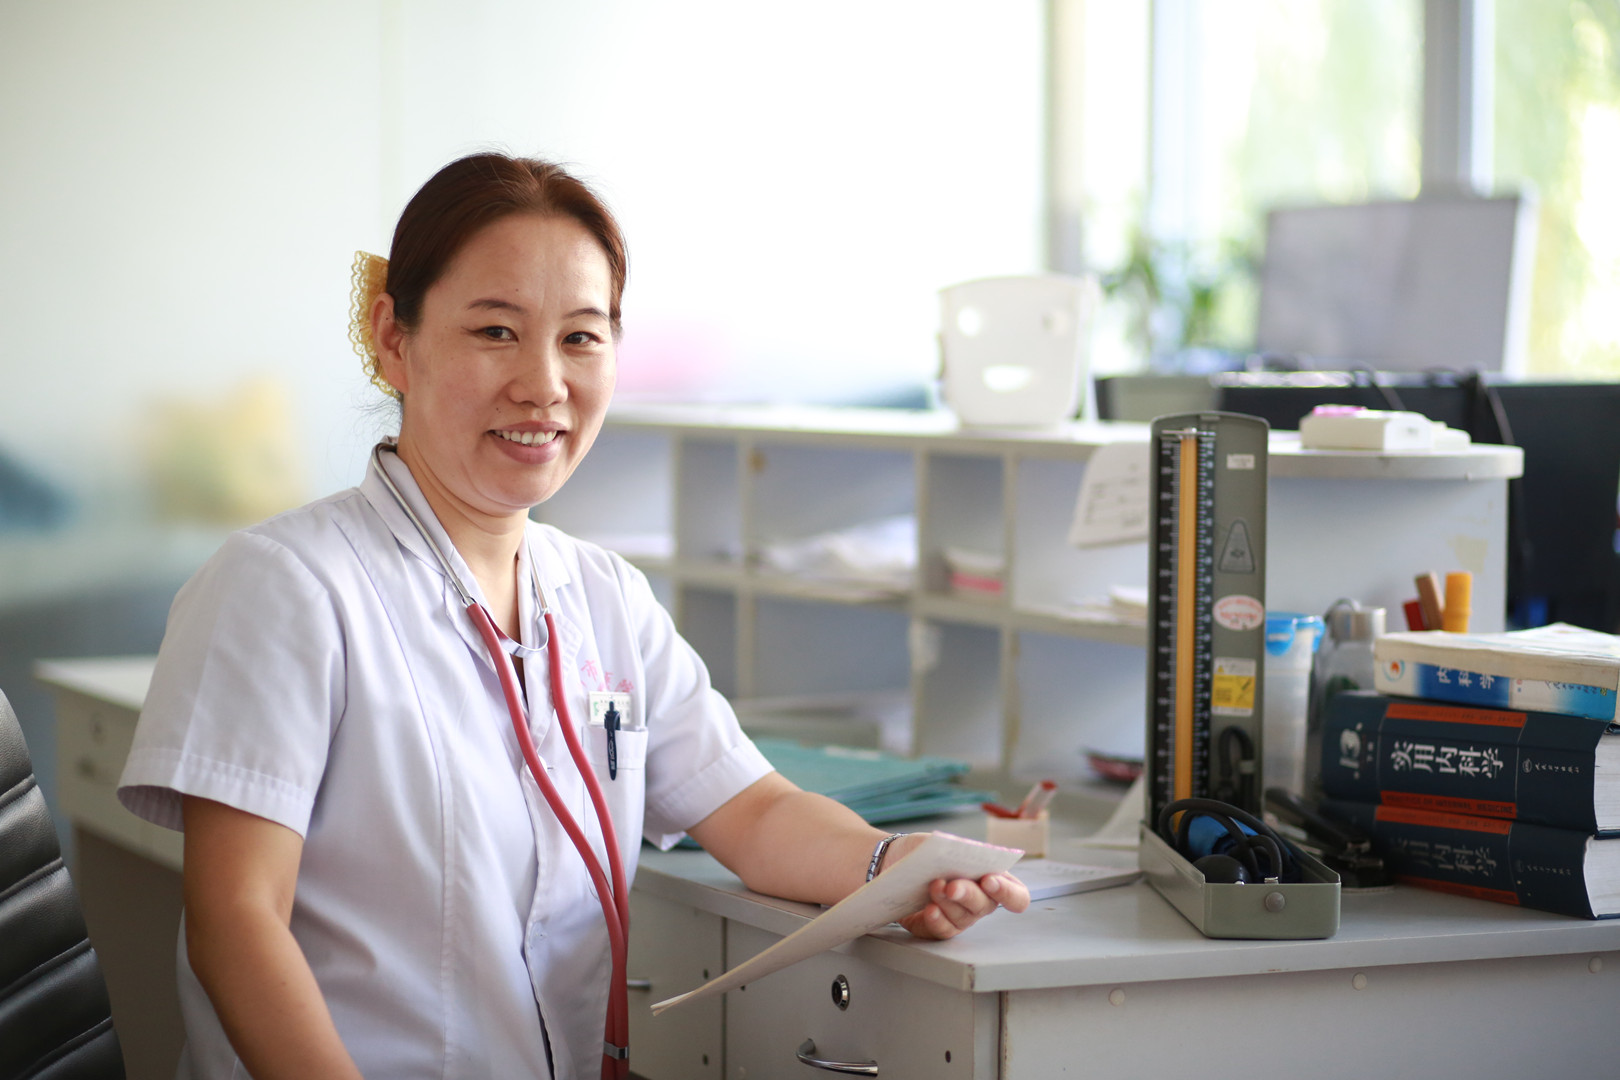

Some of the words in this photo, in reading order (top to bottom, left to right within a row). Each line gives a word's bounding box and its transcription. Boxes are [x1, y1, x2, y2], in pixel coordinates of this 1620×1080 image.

[1390, 740, 1504, 779] 实用内科学
[1435, 799, 1472, 811] INTERNAL
[1477, 803, 1513, 815] MEDICINE
